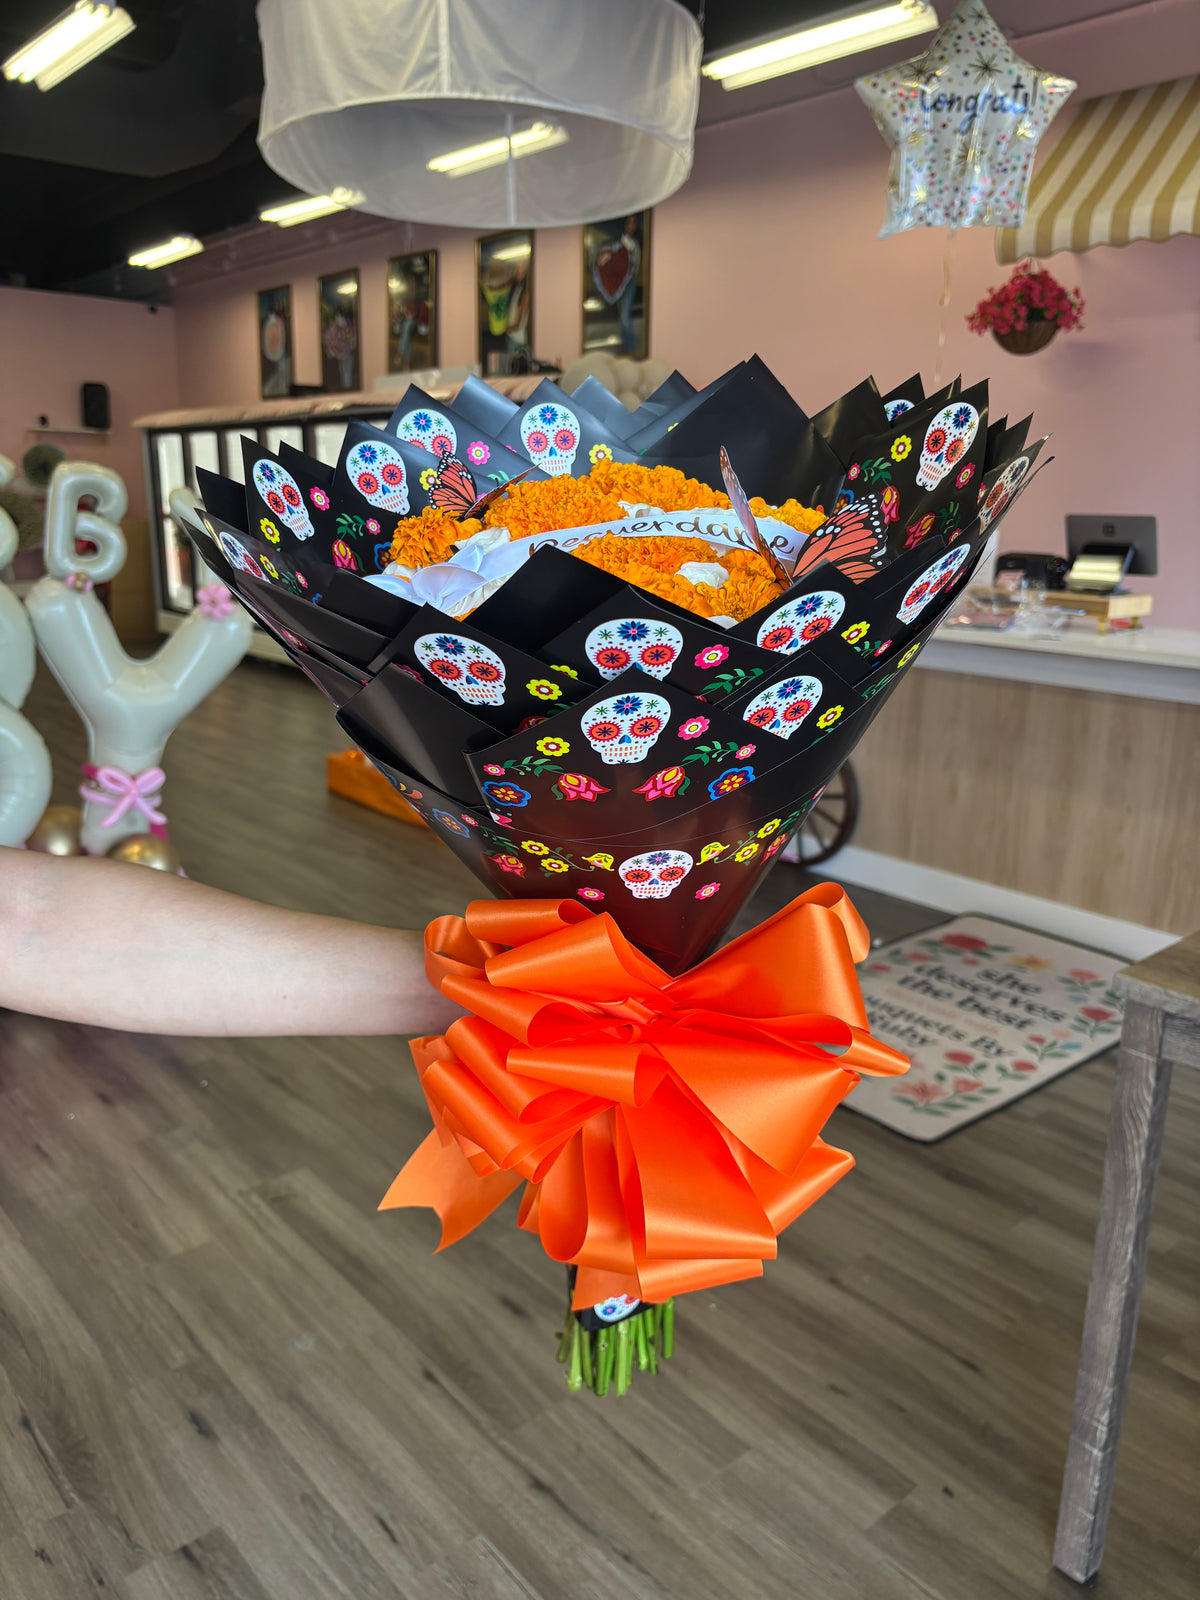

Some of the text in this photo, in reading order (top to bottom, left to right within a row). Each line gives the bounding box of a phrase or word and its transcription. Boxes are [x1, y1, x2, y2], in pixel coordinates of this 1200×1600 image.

[897, 974, 953, 1001] the
[957, 996, 1035, 1029] best
[914, 965, 1067, 1023] deserves
[977, 969, 1042, 995] she
